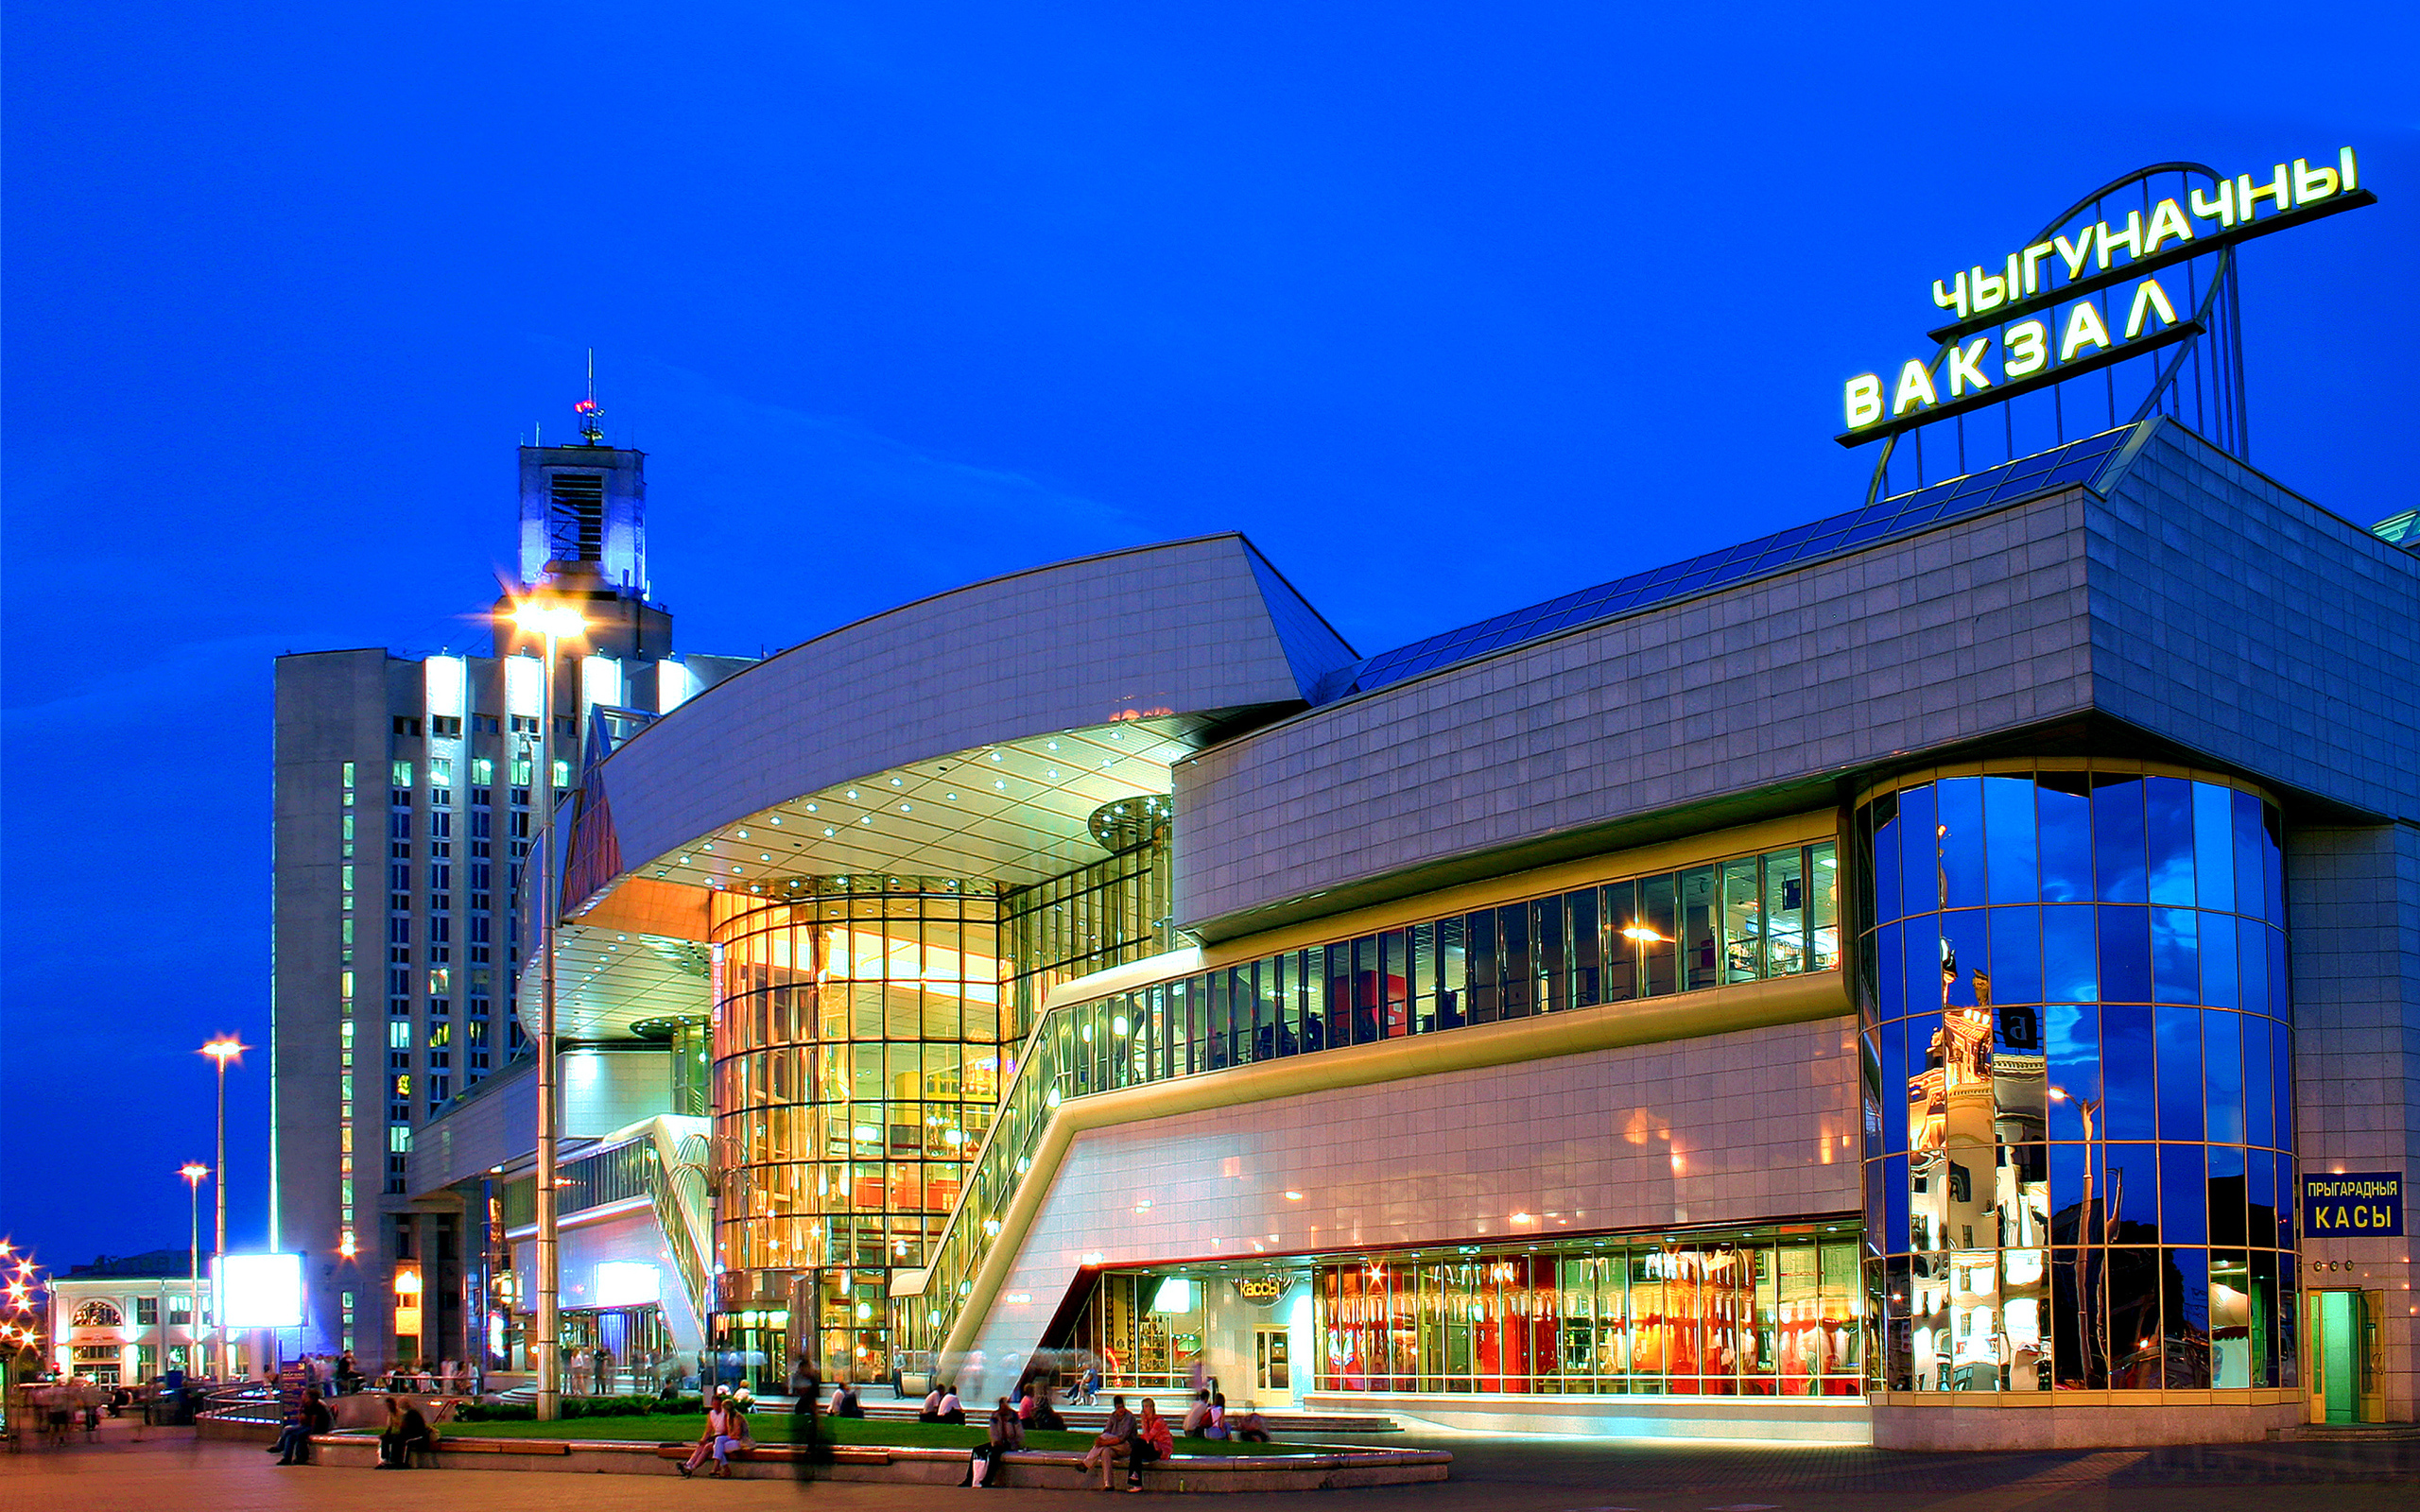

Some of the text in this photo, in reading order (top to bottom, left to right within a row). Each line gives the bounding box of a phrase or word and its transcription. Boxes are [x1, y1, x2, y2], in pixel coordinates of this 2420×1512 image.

[1932, 146, 2357, 318] ЧЫГУНАЧНЫ
[1844, 279, 2177, 430] ВАКЗАЛ
[2308, 1180, 2397, 1198] ПРЫГАРАДНЫЯ
[2315, 1205, 2392, 1228] КАСЫ
